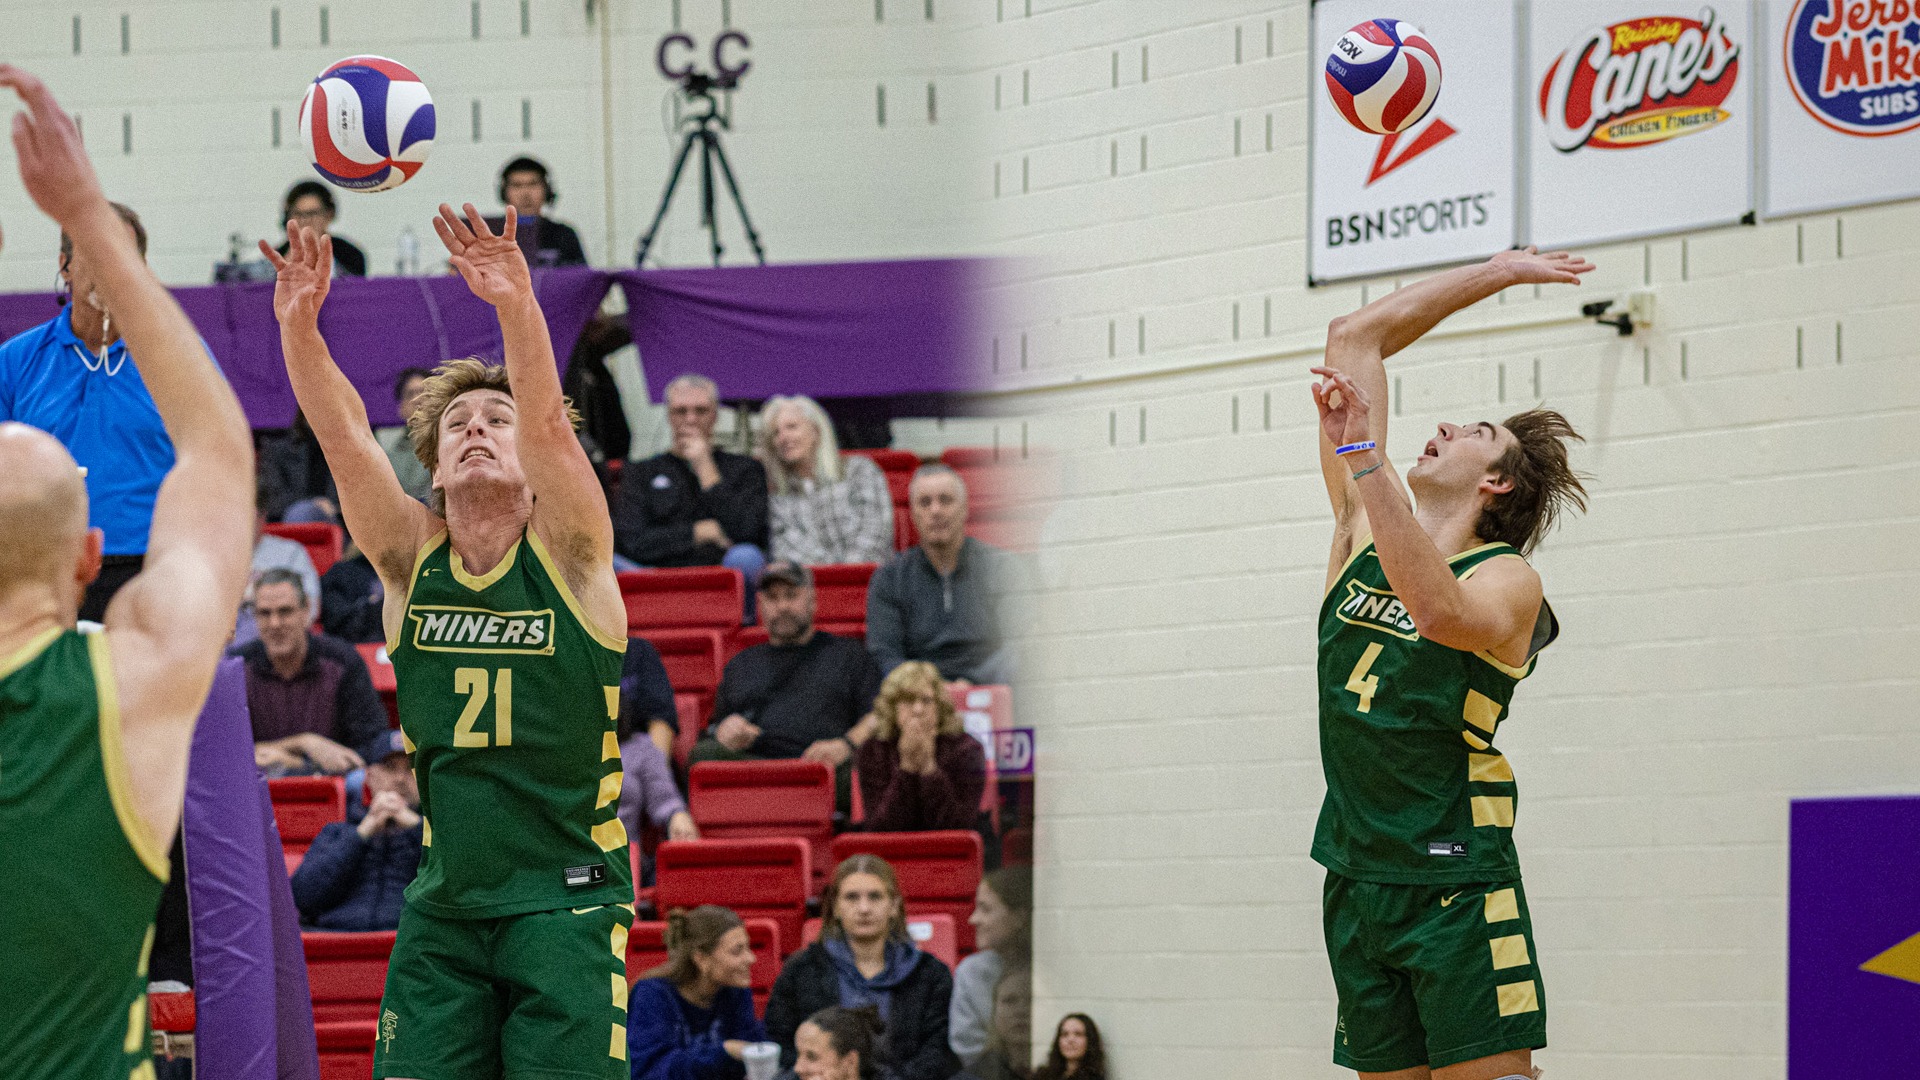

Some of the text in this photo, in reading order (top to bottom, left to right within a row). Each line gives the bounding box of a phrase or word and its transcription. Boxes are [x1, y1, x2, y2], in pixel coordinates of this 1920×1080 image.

[1612, 20, 1681, 50] Raising
[1815, 0, 1920, 37] Jers
[1546, 6, 1739, 151] Cane's
[1824, 30, 1920, 92] Mik
[1860, 89, 1919, 119] SUBS
[420, 613, 546, 645] MINERS
[1344, 641, 1385, 714] 4
[453, 667, 512, 748] 21
